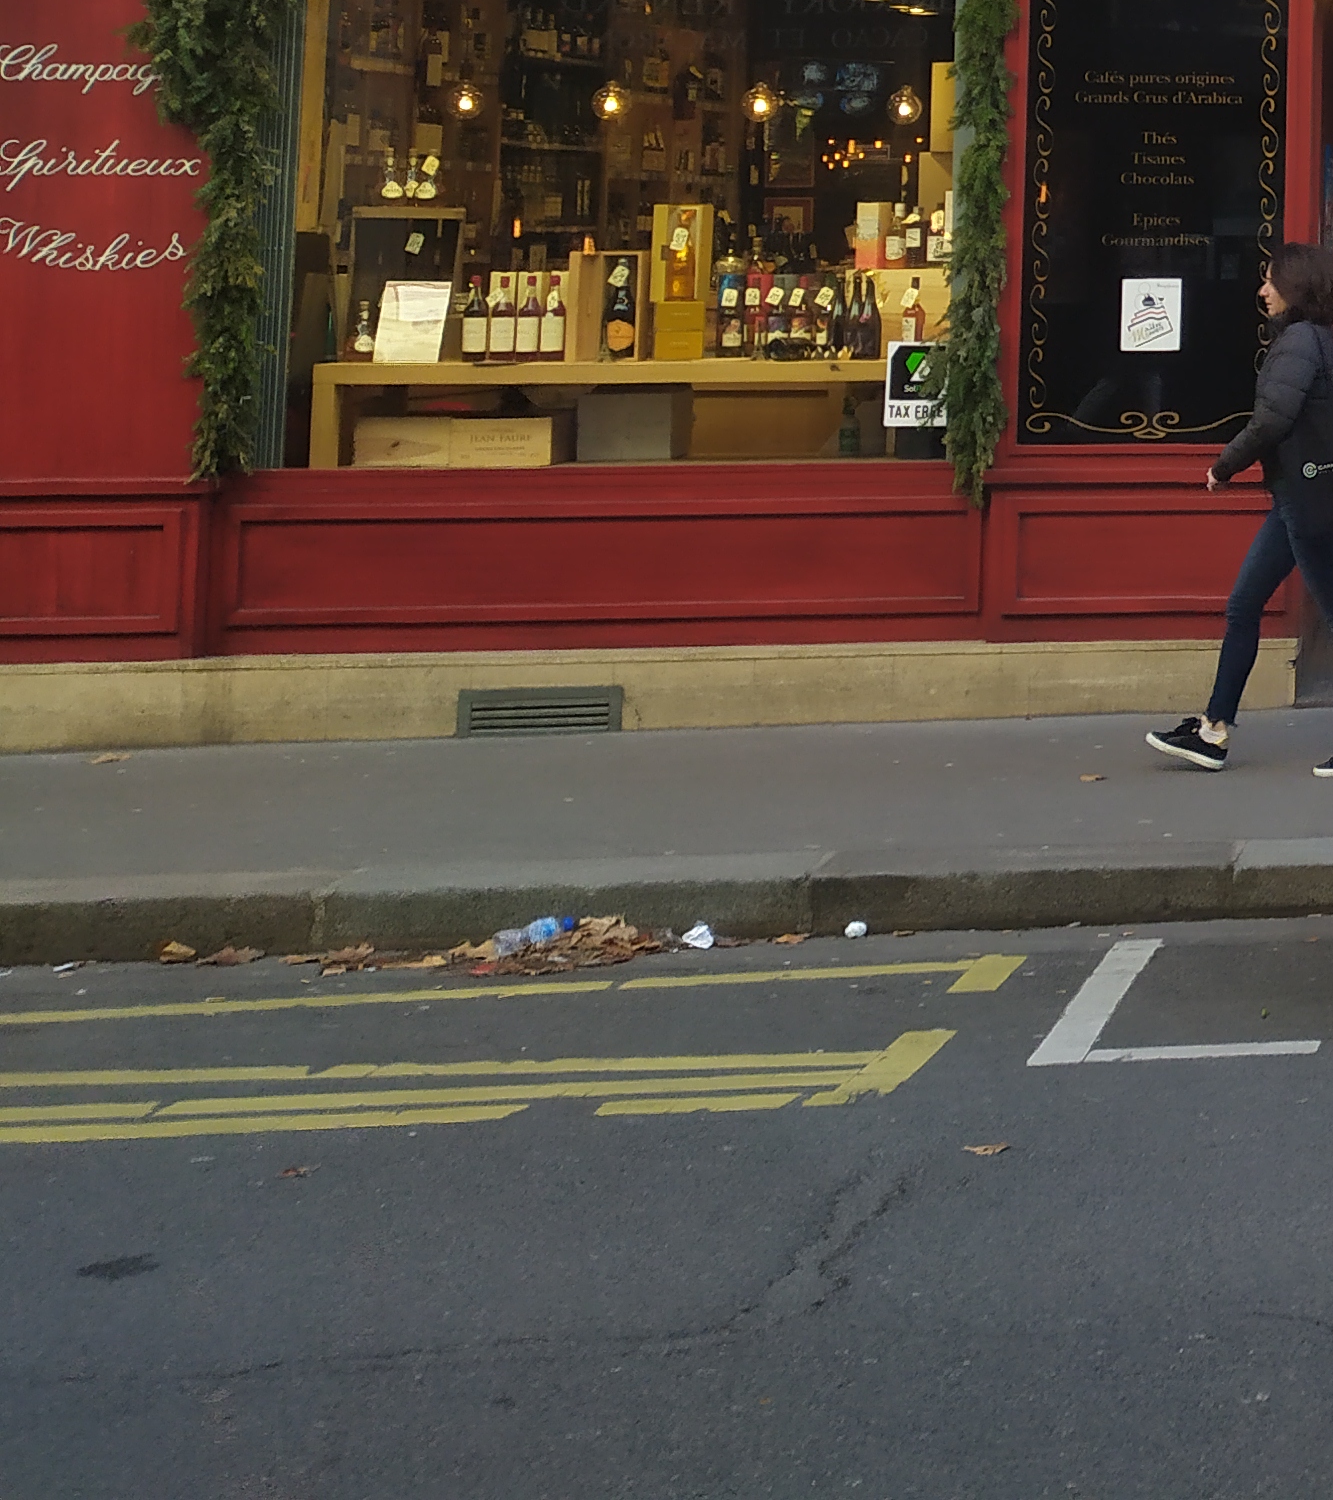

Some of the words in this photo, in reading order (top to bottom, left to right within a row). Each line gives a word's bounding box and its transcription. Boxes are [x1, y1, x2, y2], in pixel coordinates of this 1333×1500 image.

[0, 44, 162, 95] Champag
[1084, 70, 1125, 85] Cafés
[1129, 73, 1171, 88] pures
[1175, 71, 1236, 88] origines
[1075, 91, 1129, 104] Grands
[1133, 91, 1168, 104] Crus
[1141, 131, 1178, 145] Thés
[0, 139, 201, 192] Spiritueux
[1131, 152, 1186, 165] Tisanes
[1120, 172, 1195, 185] Chocolats
[1133, 212, 1181, 230] Epices
[0, 217, 186, 271] Whiskies
[1101, 233, 1211, 247] Gourmandises
[888, 404, 911, 419] TAX
